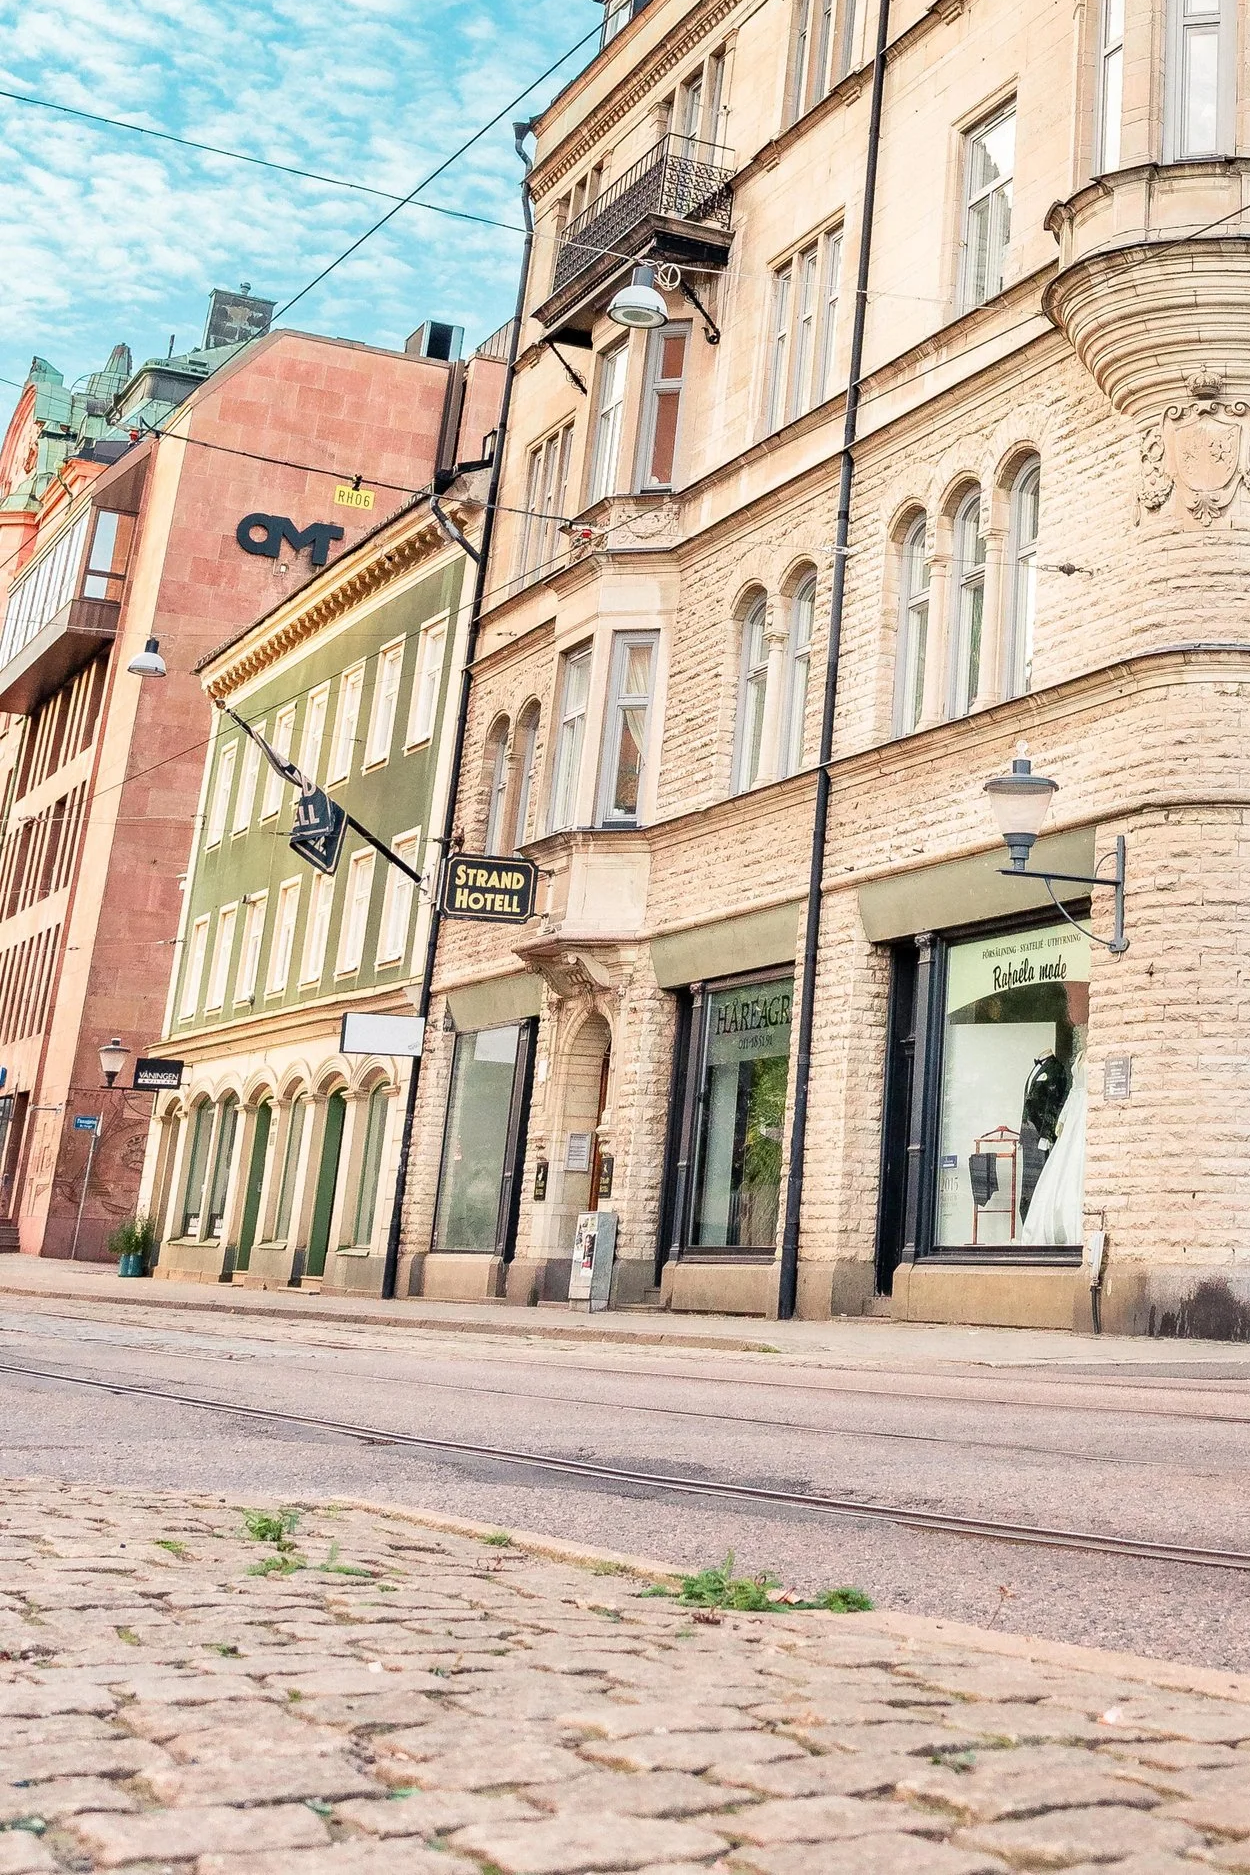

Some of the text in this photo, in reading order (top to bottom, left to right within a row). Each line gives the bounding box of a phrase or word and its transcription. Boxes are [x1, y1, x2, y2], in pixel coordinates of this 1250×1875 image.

[338, 490, 370, 507] RH06
[455, 864, 525, 890] STRAND
[454, 888, 521, 913] HOTELL
[1047, 933, 1082, 947] UTHYRNING
[993, 954, 1067, 991] Rafaéla mode
[139, 1070, 179, 1080] VÅNINGEN
